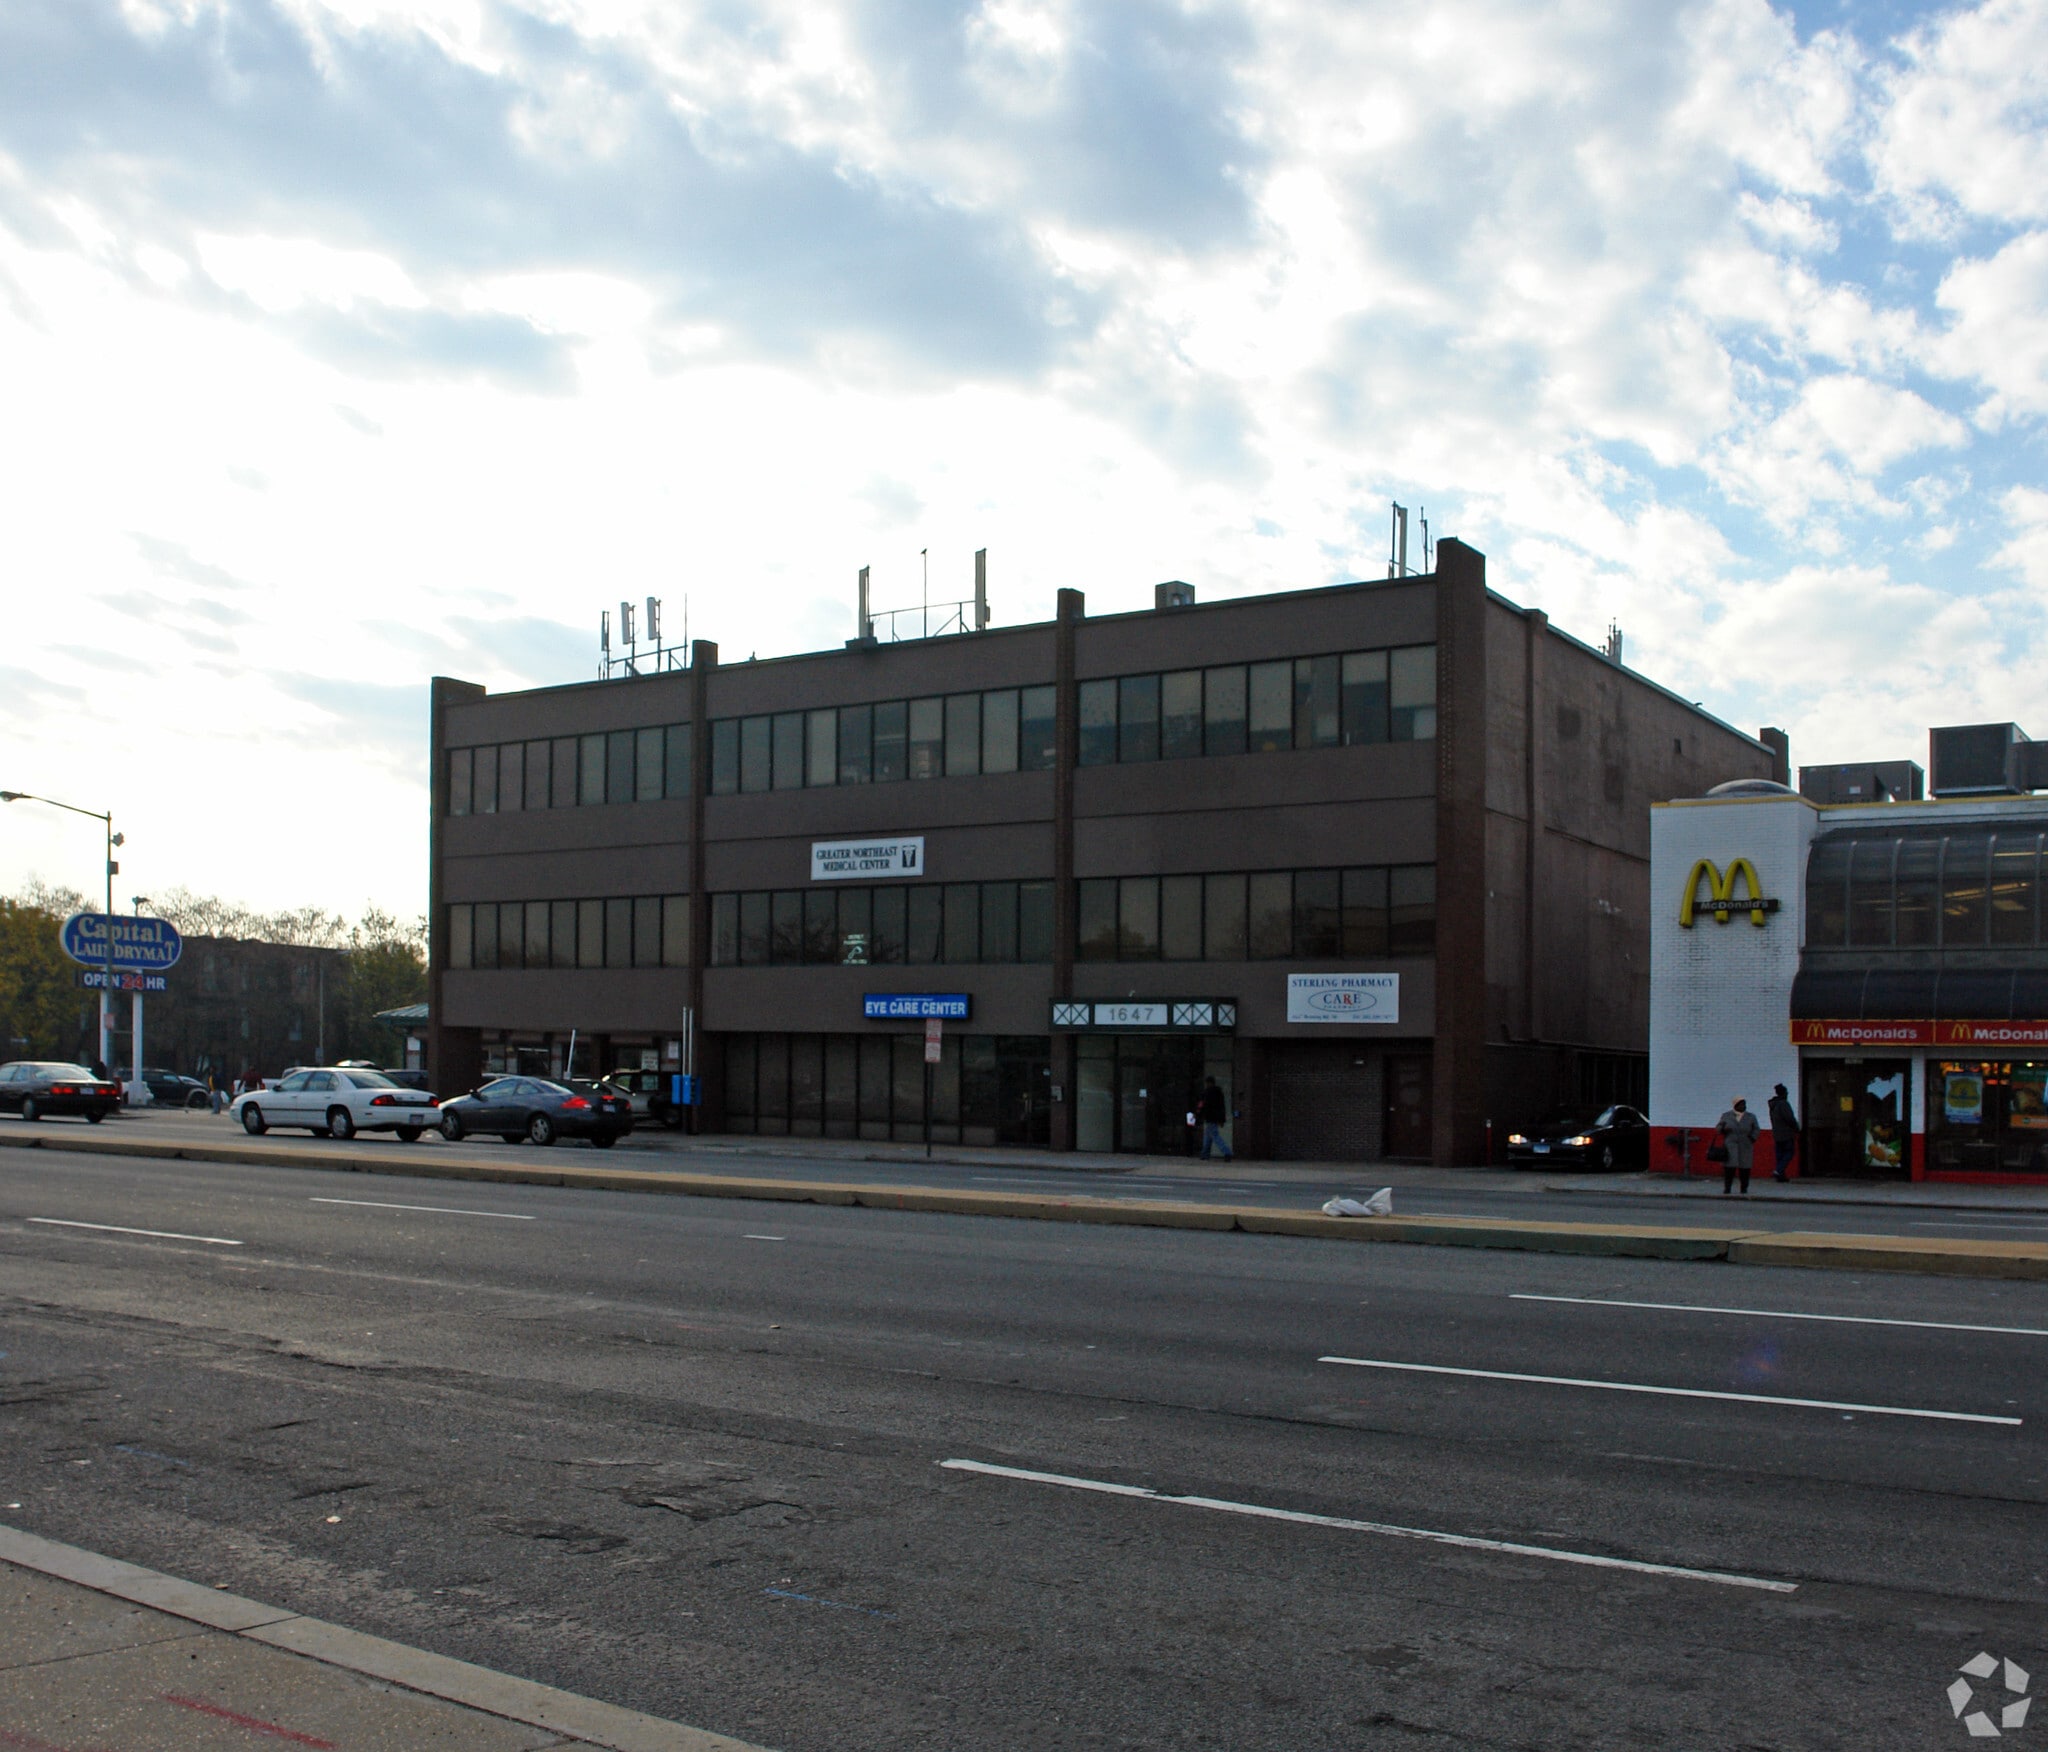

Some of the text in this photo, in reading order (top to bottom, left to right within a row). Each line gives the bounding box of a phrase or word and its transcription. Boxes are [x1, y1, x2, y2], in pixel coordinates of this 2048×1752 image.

[816, 846, 897, 860] GREATER NORTHEAST
[823, 859, 890, 872] MEDICAL CENTER
[1701, 901, 1769, 911] McDonald's
[78, 916, 163, 944] Capital
[83, 973, 166, 990] OPEN 24 HR
[1292, 978, 1393, 988] STERLING PHARMACY
[1323, 993, 1361, 1005] CARE
[865, 1001, 966, 1015] EYE CARE CENTER
[1109, 1007, 1154, 1022] 1647
[1827, 1027, 1918, 1040] McDonald's
